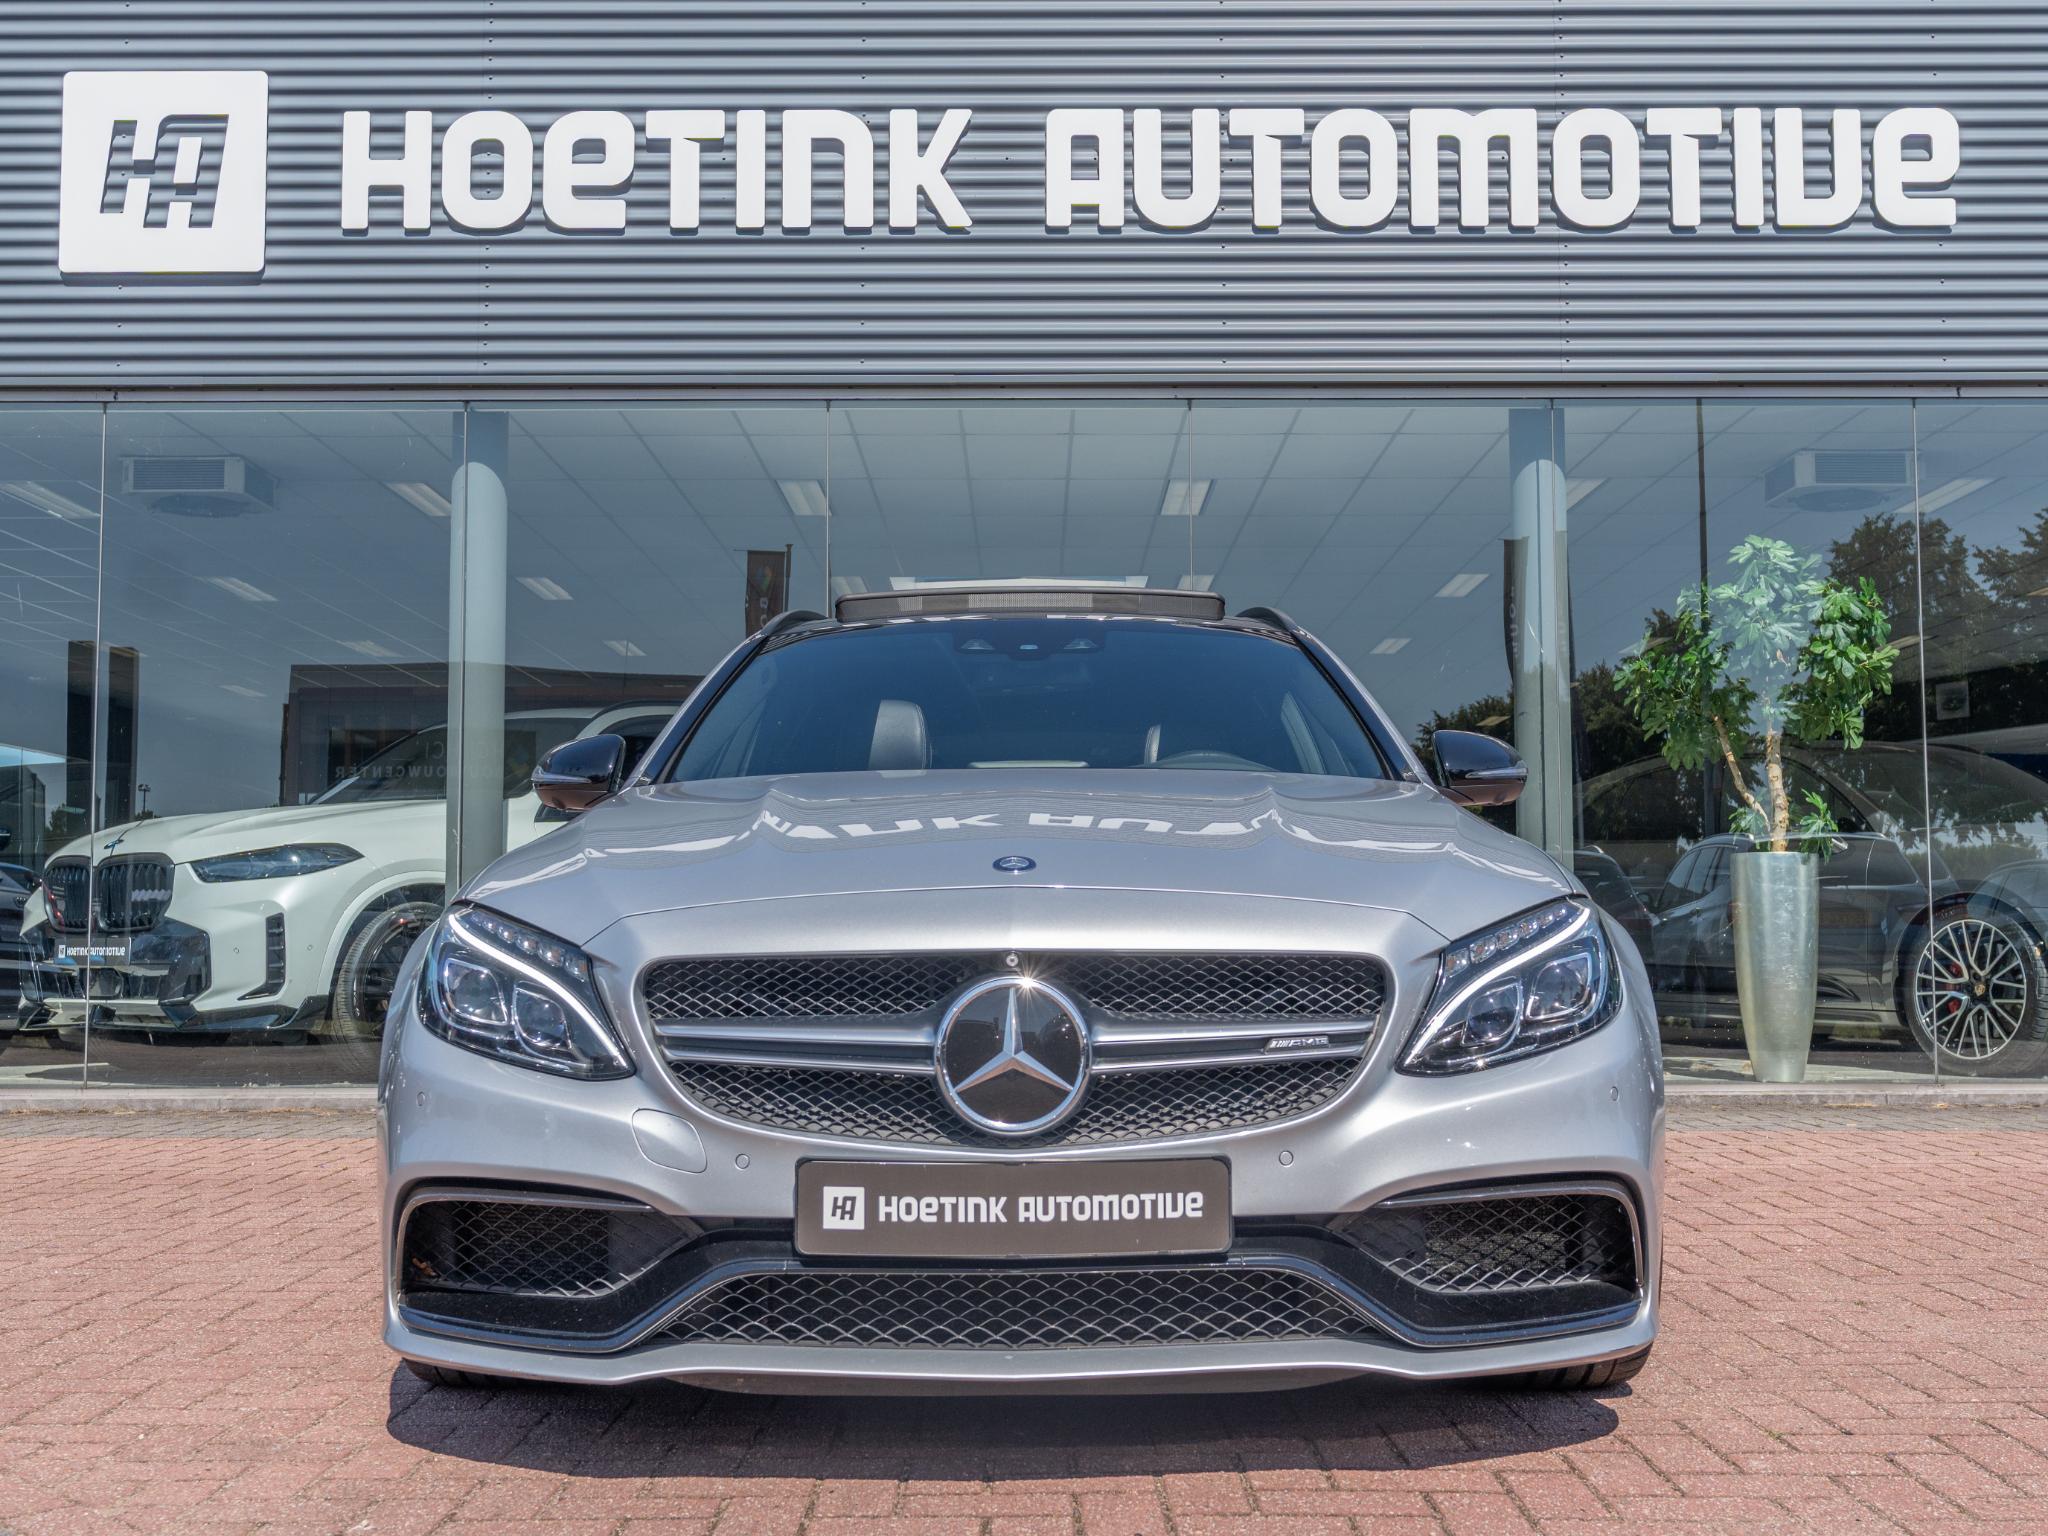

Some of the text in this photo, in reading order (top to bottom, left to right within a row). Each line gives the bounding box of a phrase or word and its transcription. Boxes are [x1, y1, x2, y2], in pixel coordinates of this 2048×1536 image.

[341, 107, 1959, 229] HOETINK AUTOMOTIVE
[878, 1191, 1203, 1223] HOETINK AUTOMOTIVE
